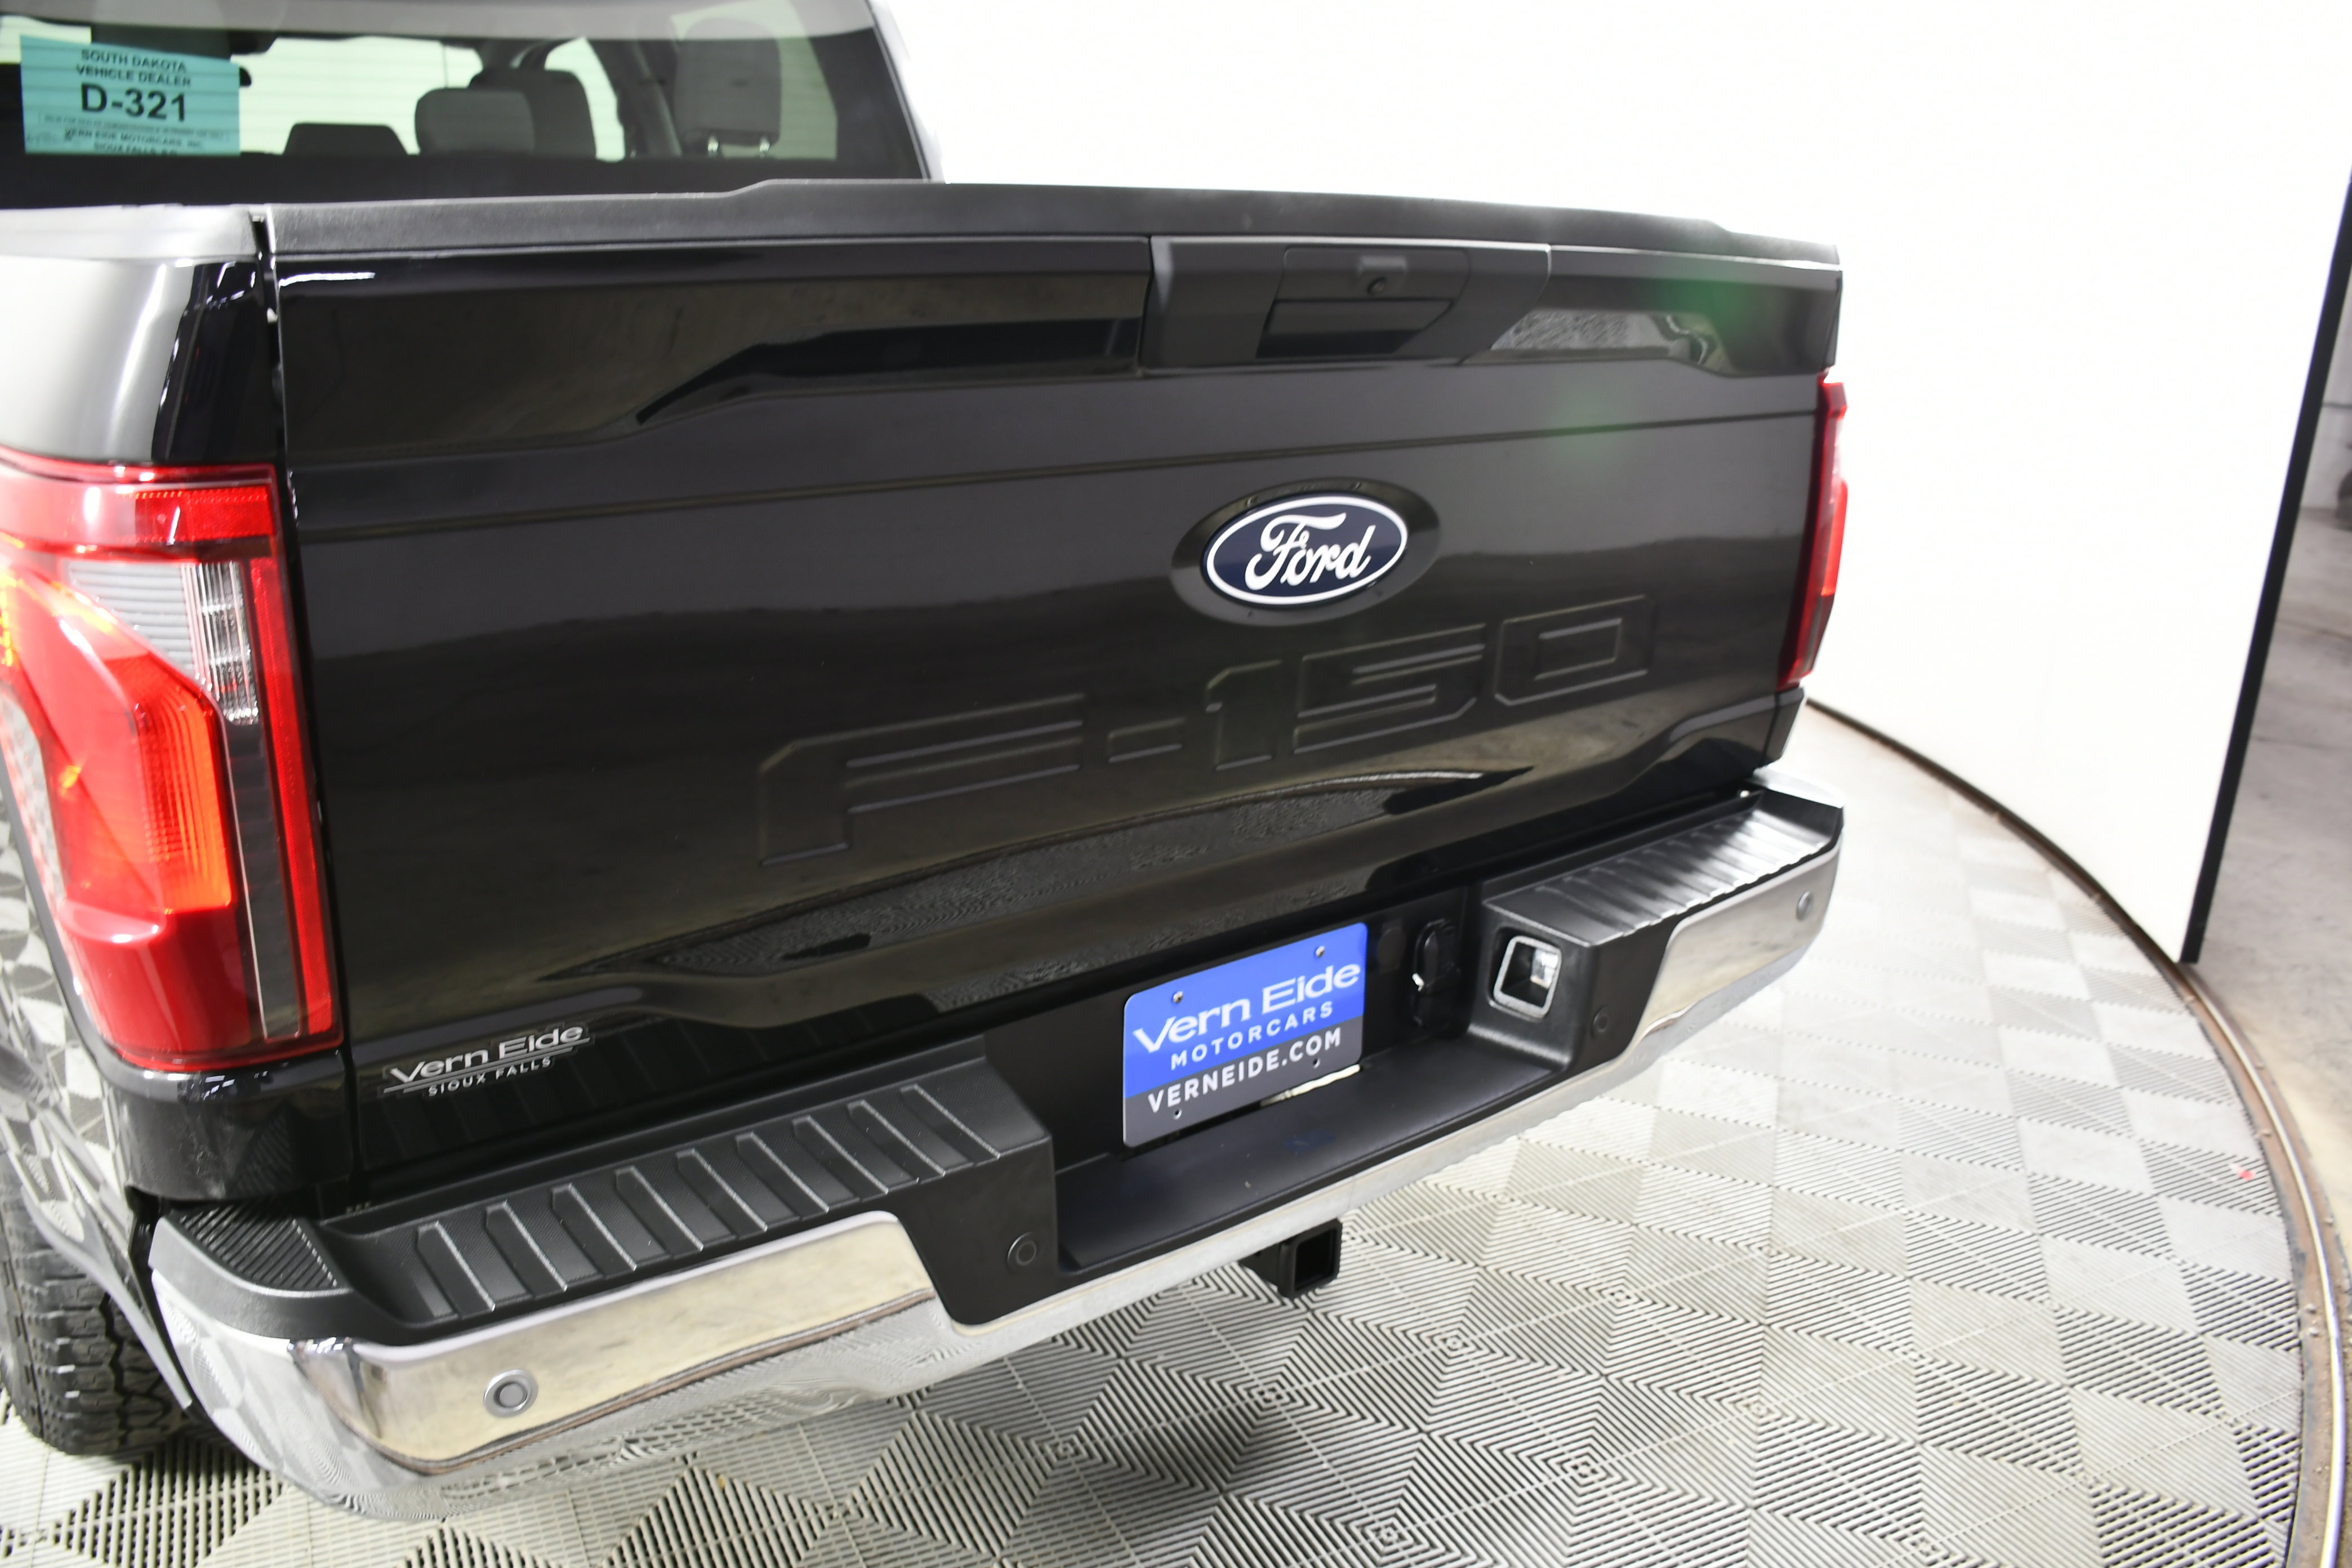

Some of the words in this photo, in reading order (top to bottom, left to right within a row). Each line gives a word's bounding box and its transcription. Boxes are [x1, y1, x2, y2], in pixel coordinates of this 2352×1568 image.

[77, 64, 134, 81] VEHICLE
[138, 71, 191, 88] DEALER
[81, 49, 128, 66] SOUTH
[132, 54, 186, 73] DAKOTA
[81, 82, 185, 122] D-321
[1245, 513, 1376, 590] Ford
[758, 595, 1654, 867] F-150
[1133, 997, 1251, 1053] Vern
[1261, 964, 1361, 1014] Eide
[1171, 1001, 1333, 1070] MOTORCARS
[391, 1048, 489, 1083] Vern
[498, 1026, 583, 1060] Eide
[428, 1072, 486, 1097] SIOUX
[495, 1055, 552, 1080] FALLS
[1148, 1027, 1341, 1113] VERNEIDE.COM
